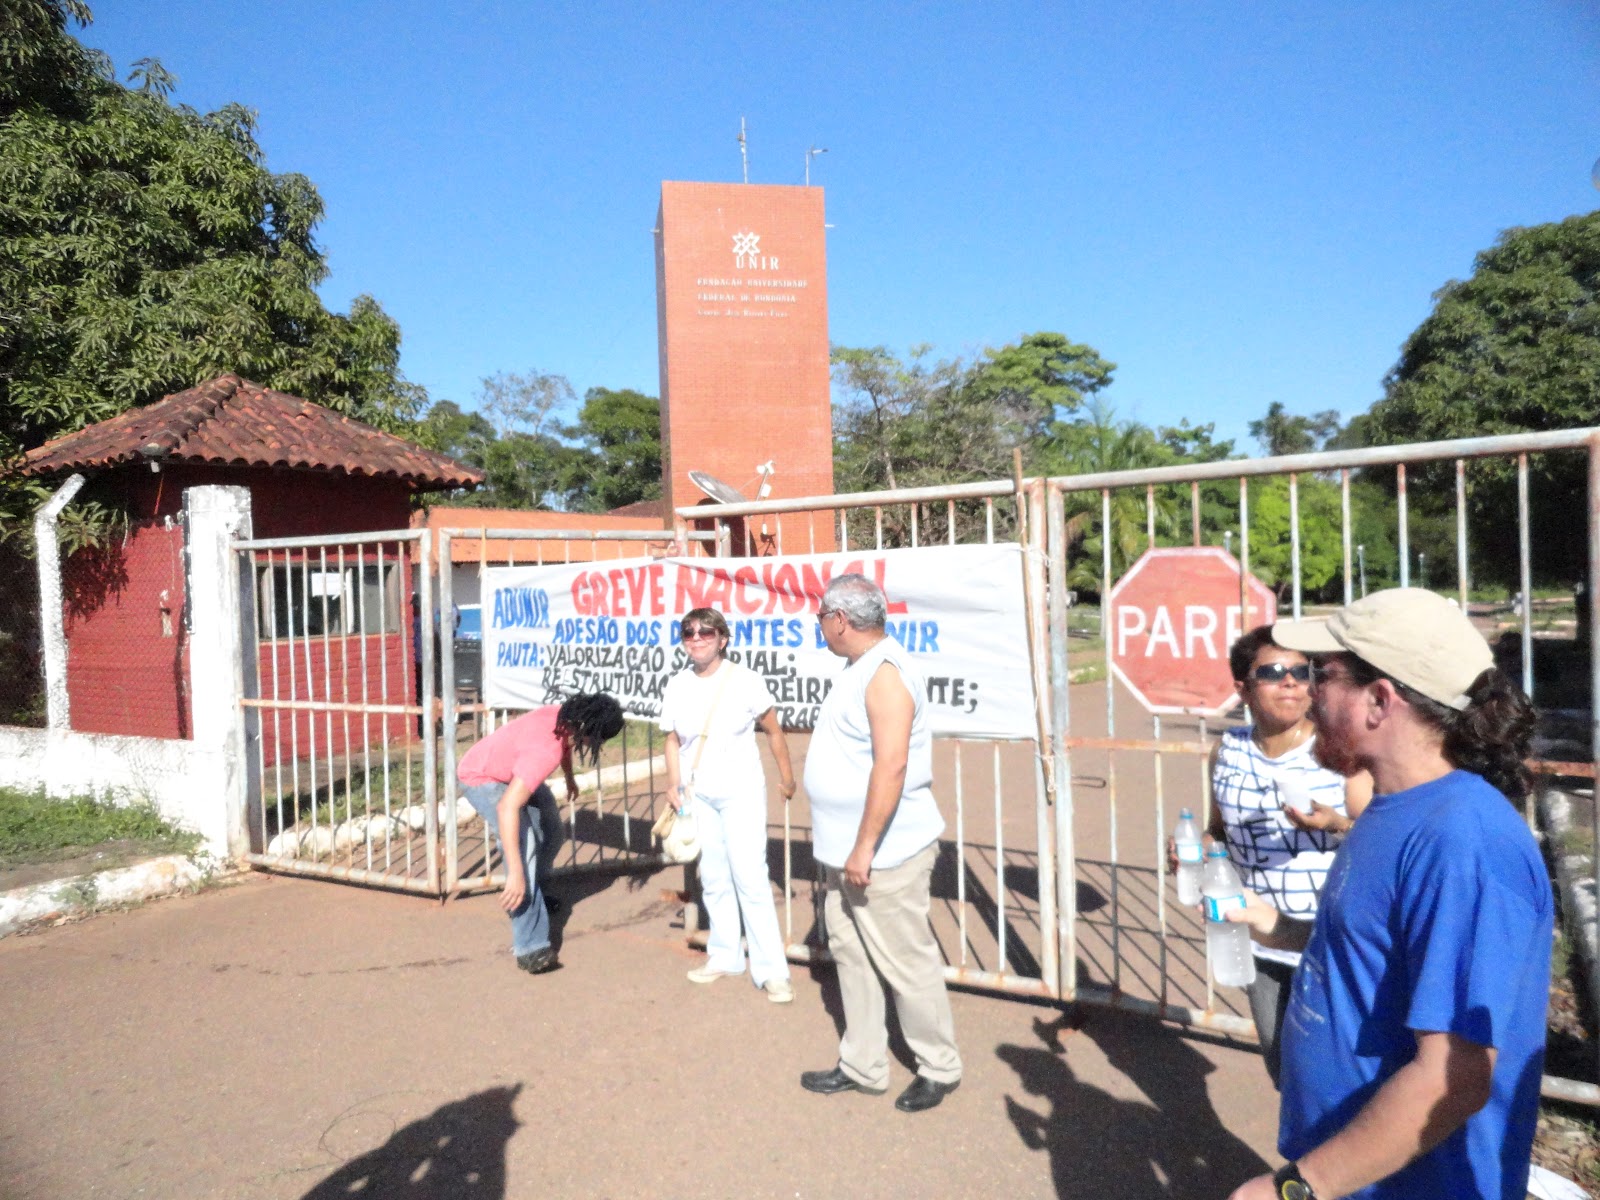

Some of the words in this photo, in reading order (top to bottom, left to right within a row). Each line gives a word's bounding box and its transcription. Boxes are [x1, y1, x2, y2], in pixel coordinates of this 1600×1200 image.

[735, 256, 779, 270] UNIR
[571, 563, 665, 617] GREVE
[674, 558, 909, 615] NACIONL
[492, 586, 551, 628] ADUNIR
[552, 615, 619, 645] ADESÃO
[626, 619, 663, 646] DOS
[670, 618, 804, 648] DNTES
[884, 620, 940, 652] NIR
[496, 641, 545, 668] PAUTA:
[546, 641, 665, 675] VALORIZAÇÃO
